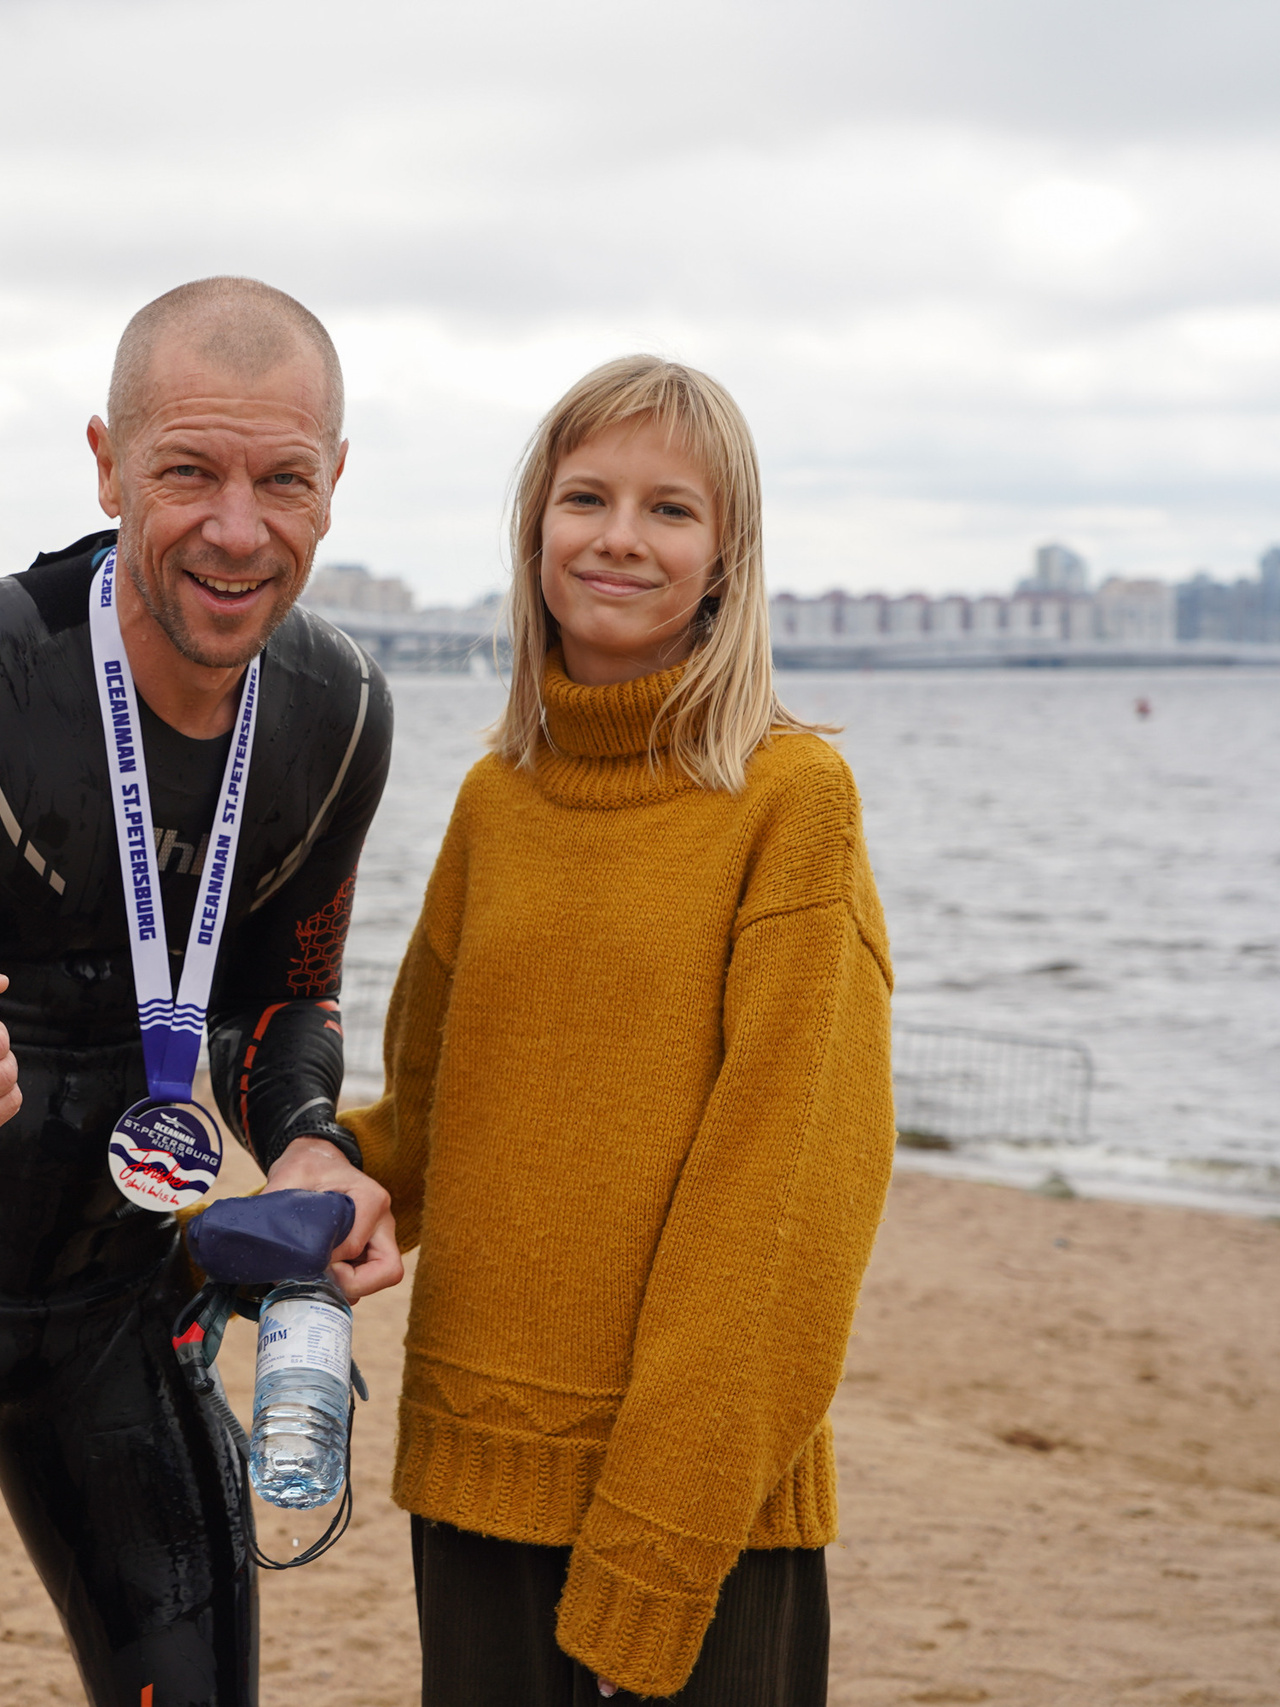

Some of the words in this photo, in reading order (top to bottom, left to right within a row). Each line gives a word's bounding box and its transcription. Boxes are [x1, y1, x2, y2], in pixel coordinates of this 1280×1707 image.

[101, 546, 117, 608] 2.08.2021
[104, 660, 137, 774] OCEANMAN
[122, 783, 157, 941] ST.PETERSBURG
[197, 834, 231, 945] OCEANMAN
[124, 1119, 218, 1166] ST.PETERSBURG
[151, 1138, 185, 1158] RUSSIA
[154, 1122, 196, 1145] OCEANMAN
[119, 1147, 190, 1188] Finisher
